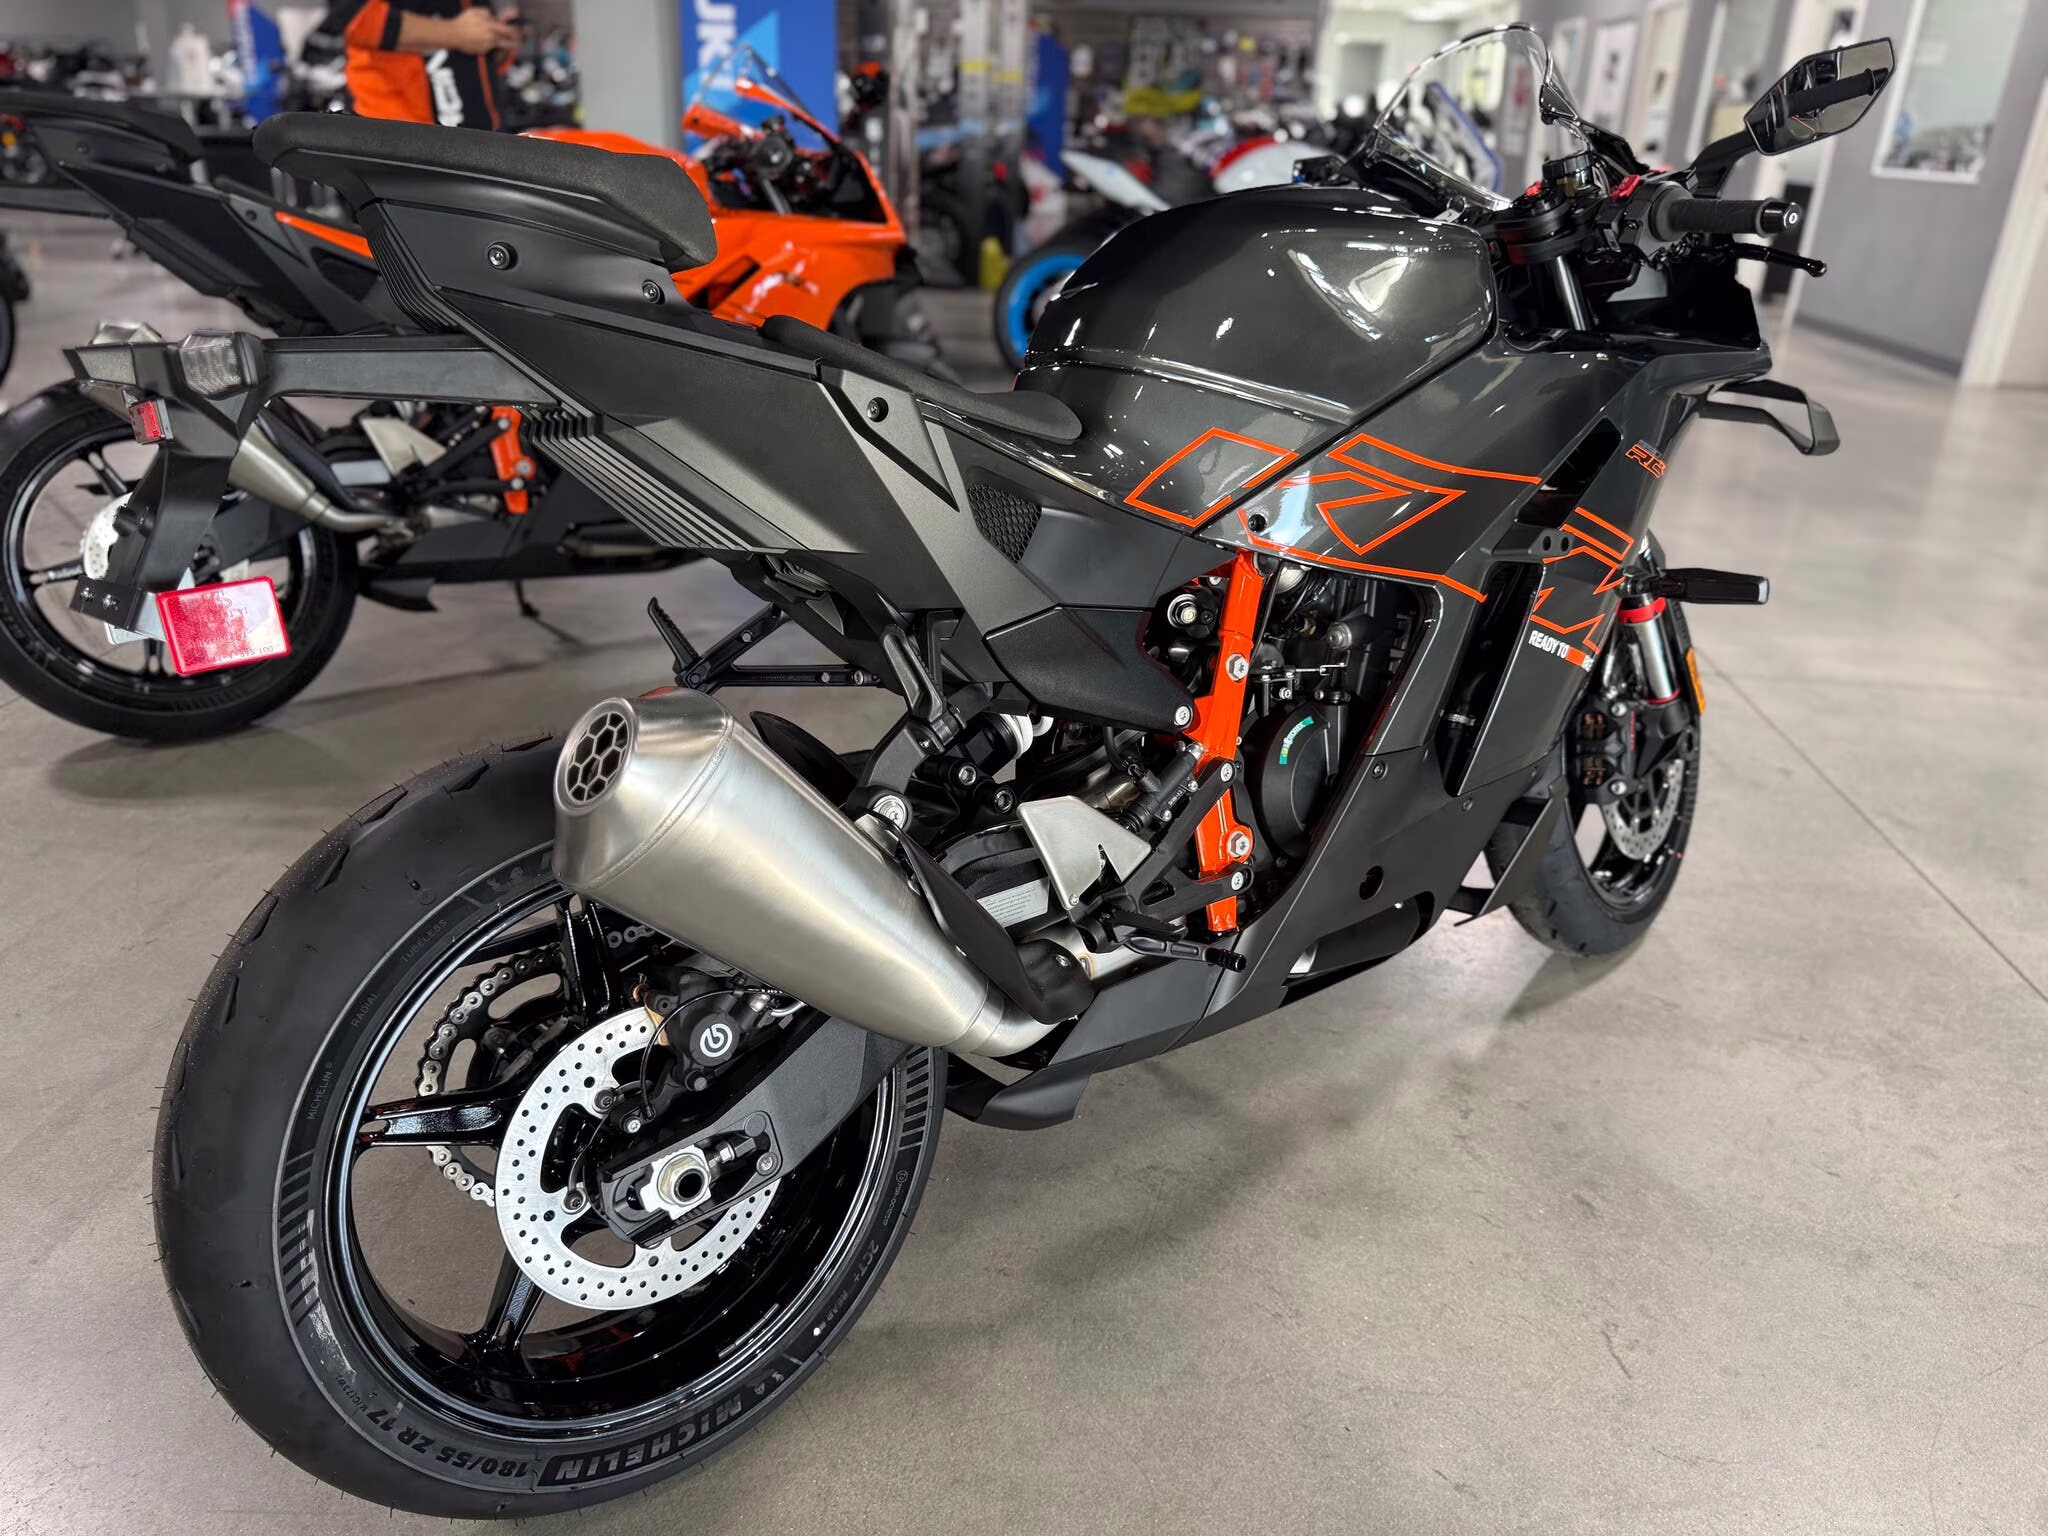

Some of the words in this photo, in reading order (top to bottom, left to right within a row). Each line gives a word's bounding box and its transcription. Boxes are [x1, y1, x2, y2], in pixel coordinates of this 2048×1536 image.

[1528, 630, 1559, 655] READY
[1556, 640, 1570, 659] TO
[402, 919, 448, 963] TUBELESS
[351, 993, 380, 1028] RADIAL
[308, 1070, 334, 1120] MICHELIN
[366, 1408, 397, 1432] 17
[396, 1425, 436, 1454] ZR
[555, 1396, 742, 1481] MICHELIN
[436, 1445, 528, 1479] 180/55
